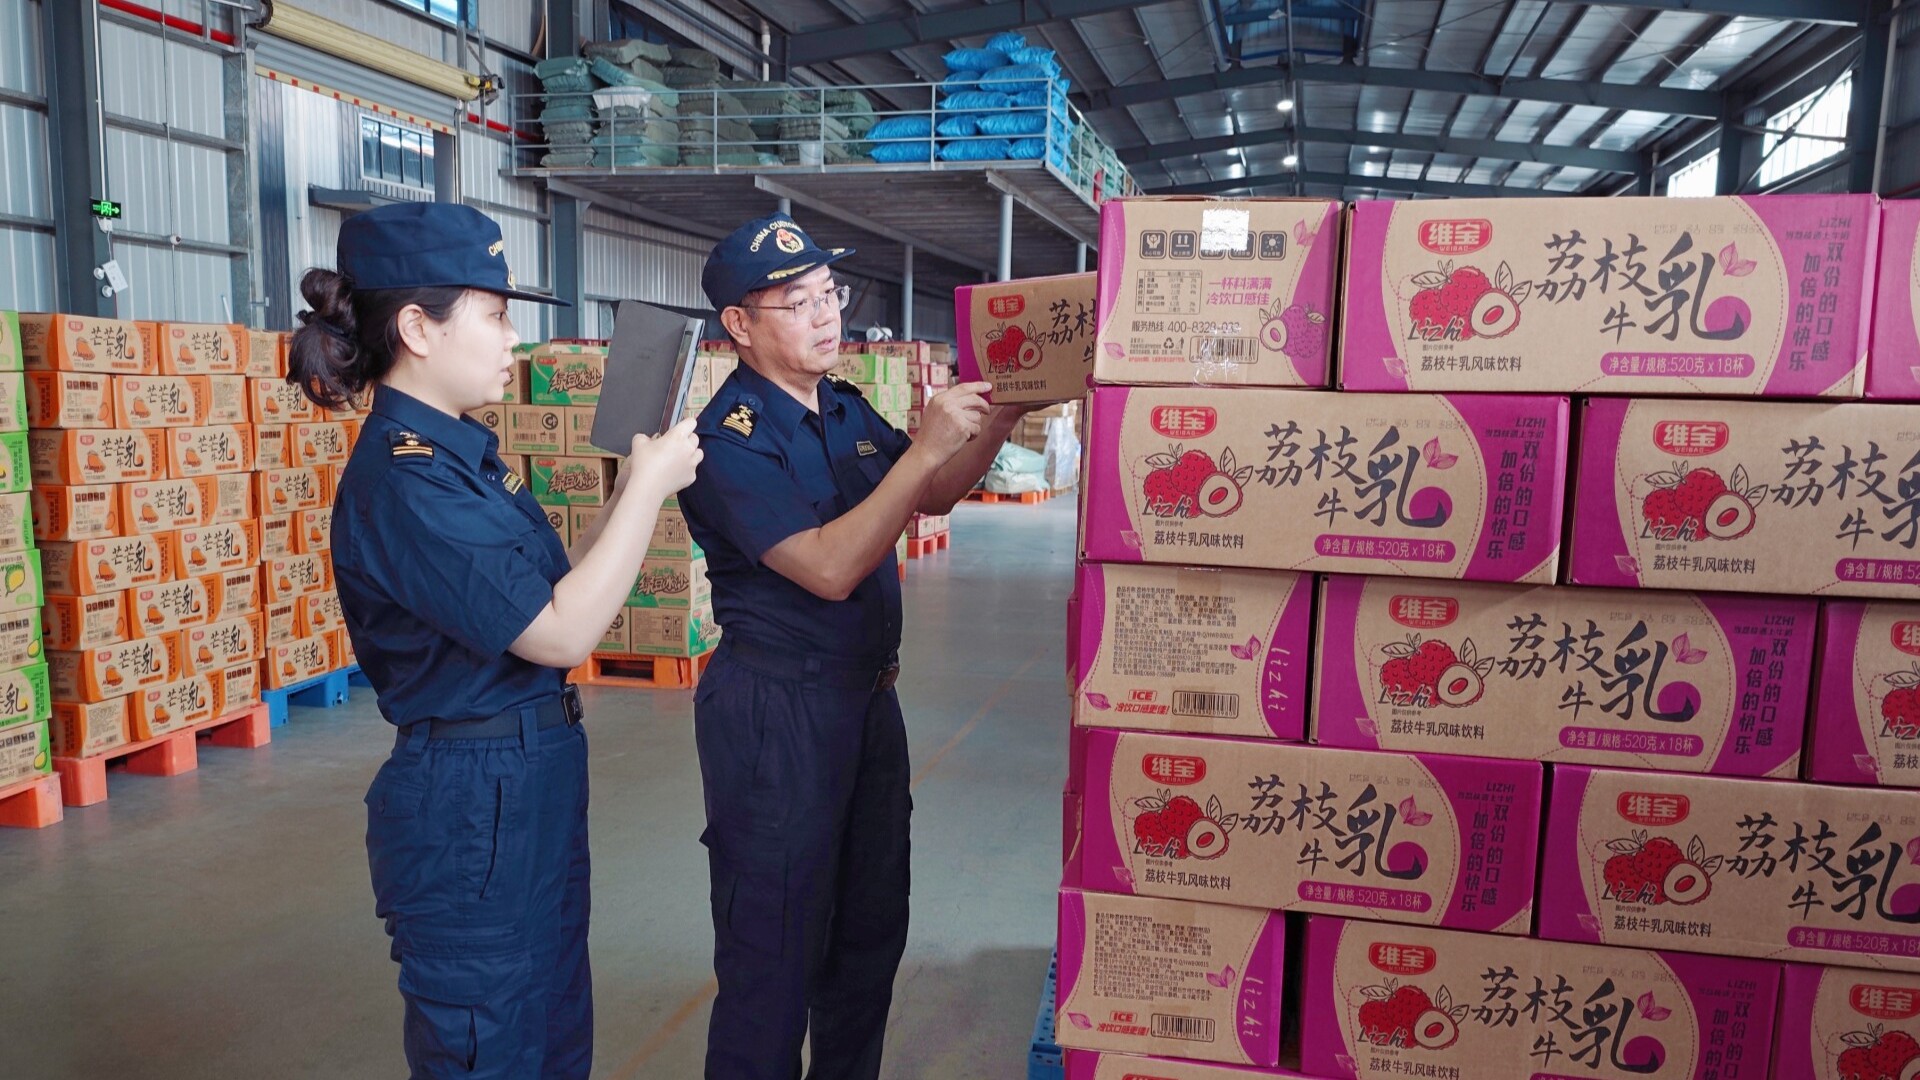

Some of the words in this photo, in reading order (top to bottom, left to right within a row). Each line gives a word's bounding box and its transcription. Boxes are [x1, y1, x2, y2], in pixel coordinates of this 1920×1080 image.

[1428, 223, 1481, 245] 维宝
[1819, 218, 1851, 228] LIZHI
[751, 228, 771, 252] CHINA
[1208, 277, 1272, 290] 一杯料满满
[1206, 292, 1270, 306] 冷饮口感佳
[1811, 242, 1844, 361] 双份的口感
[1789, 253, 1822, 371] 加倍的快乐
[1131, 321, 1165, 333] 服务热线
[1407, 315, 1464, 342] Lizhi
[1421, 356, 1522, 372] 荔枝牛乳风味饮料
[1159, 409, 1206, 430] 维宝
[1515, 417, 1547, 428] LIZHI
[1663, 424, 1717, 447] 维宝
[1487, 450, 1517, 559] 加倍的快乐
[1508, 441, 1540, 551] 双份的口感
[1142, 495, 1193, 520] Lizhi
[1153, 530, 1244, 549] 荔枝牛乳风味饮料
[1640, 517, 1698, 542] Lizhi
[1653, 555, 1756, 574] 荔枝牛乳风味饮料
[1398, 600, 1448, 620] 维宝
[1764, 615, 1795, 626] LIZHI
[1132, 691, 1153, 700] ICE
[1378, 684, 1430, 709] Lizhi
[1734, 647, 1766, 755] 加倍的快乐
[1755, 639, 1788, 746] 双份的口感
[1391, 719, 1485, 740] 荔枝牛乳风味饮料
[1151, 757, 1195, 778] 维宝
[1486, 782, 1516, 793] LIZHI
[1627, 796, 1678, 818] 维宝
[1133, 837, 1182, 860] Lizhi
[1481, 805, 1509, 905] 双份的口感
[1461, 812, 1489, 911] 加倍的快乐
[1145, 868, 1231, 890] 荔枝牛乳风味饮料
[1601, 882, 1657, 906] Lizhi
[1613, 916, 1712, 938] 荔枝牛乳风味饮料
[1378, 945, 1425, 968] 维宝
[1727, 979, 1757, 990] LIZHI
[1860, 988, 1913, 1012] 维宝
[1113, 1013, 1133, 1022] ICE
[1357, 1026, 1408, 1049] Lizhi
[1369, 1057, 1460, 1080] 荔枝牛乳风味饮料
